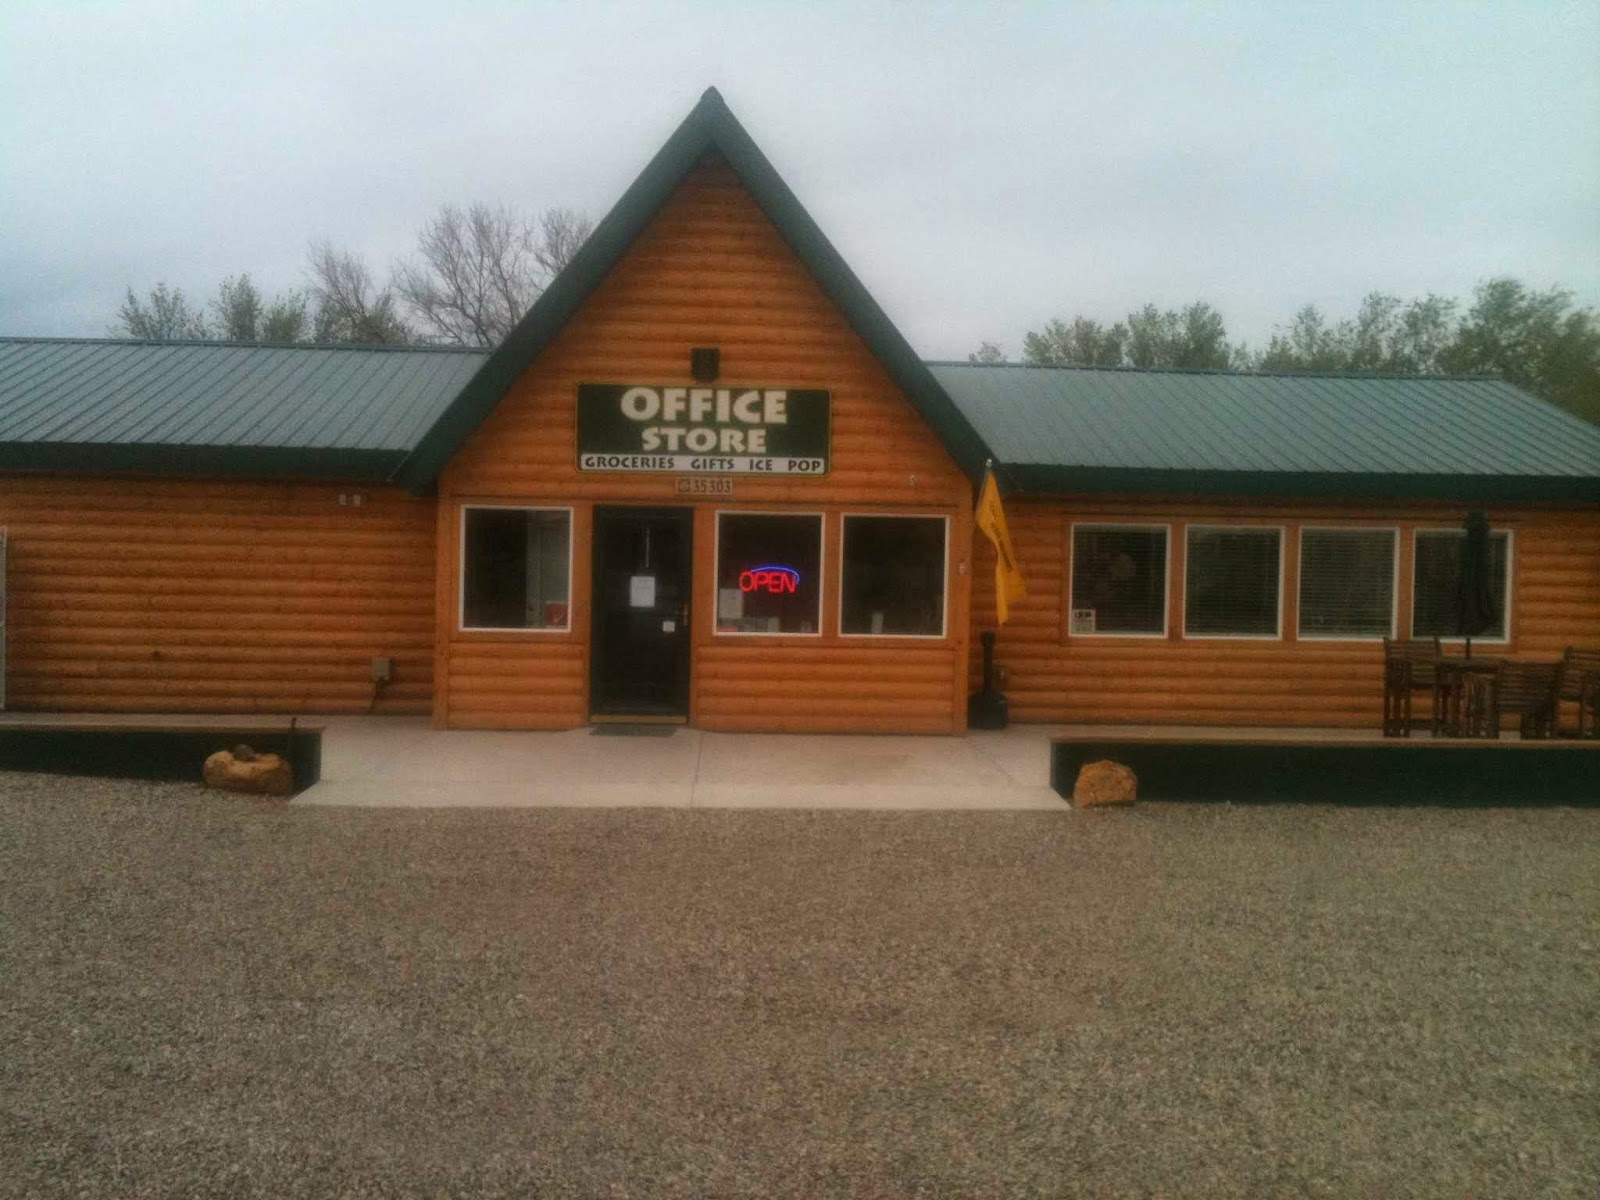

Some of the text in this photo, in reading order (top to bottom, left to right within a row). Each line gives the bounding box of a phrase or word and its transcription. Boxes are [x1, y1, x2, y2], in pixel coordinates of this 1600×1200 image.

[620, 387, 788, 424] OFFICE
[641, 426, 767, 453] STORE
[585, 456, 821, 472] GROCERIES GIFTS ICE POP
[693, 479, 731, 493] 35303
[739, 569, 797, 594] OPEN
